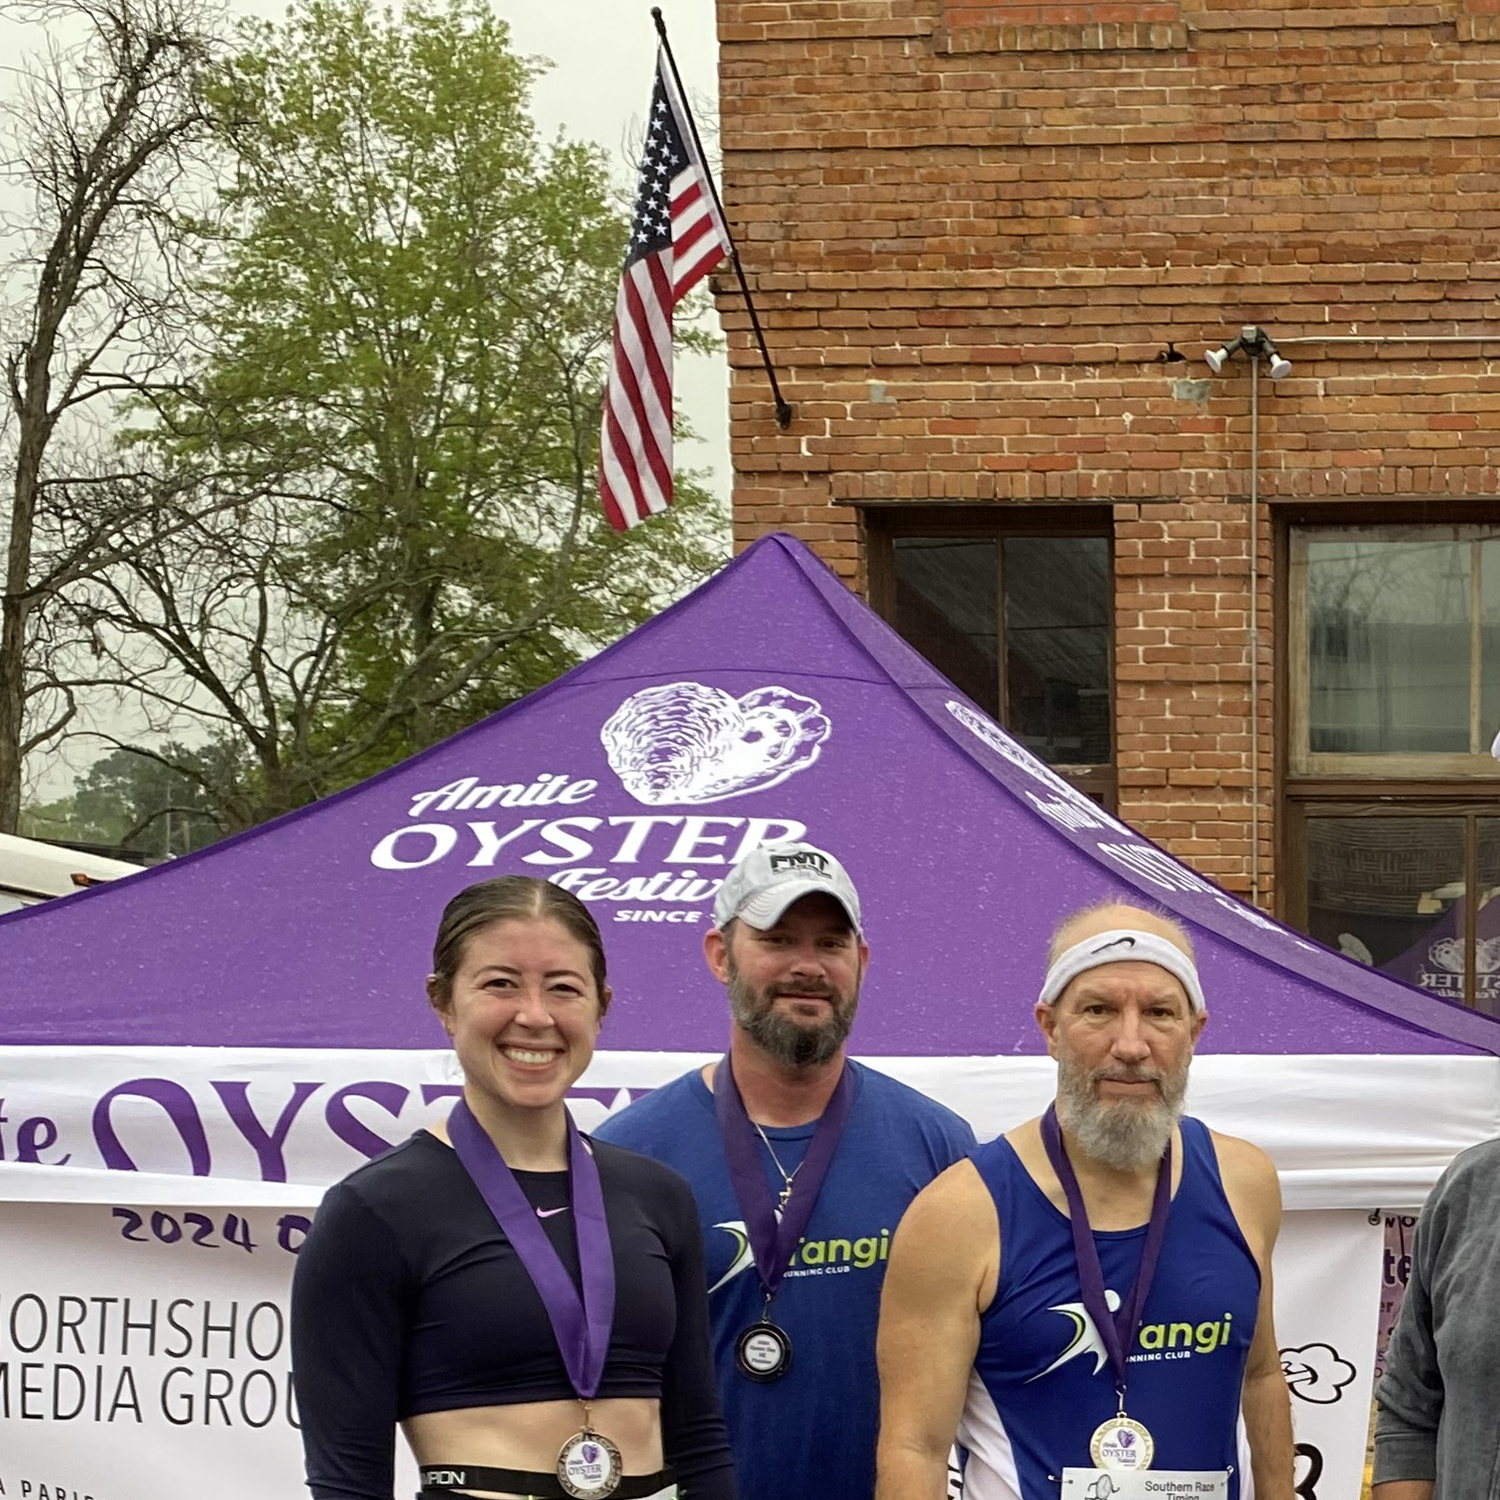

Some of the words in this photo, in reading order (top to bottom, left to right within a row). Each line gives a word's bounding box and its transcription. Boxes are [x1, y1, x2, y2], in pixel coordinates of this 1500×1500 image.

[408, 773, 598, 817] Amite
[370, 815, 808, 870] OYSTER
[612, 909, 703, 923] SINCE
[112, 1207, 257, 1254] 2024
[825, 1265, 850, 1274] CLUB
[1138, 1312, 1232, 1354] angi
[1126, 1353, 1162, 1363] NNING
[1164, 1351, 1191, 1360] CLUB
[1102, 1449, 1136, 1458] OYSTER
[568, 1464, 602, 1475] OYSTER
[1145, 1481, 1192, 1492] Southern
[1195, 1482, 1215, 1492] Race
